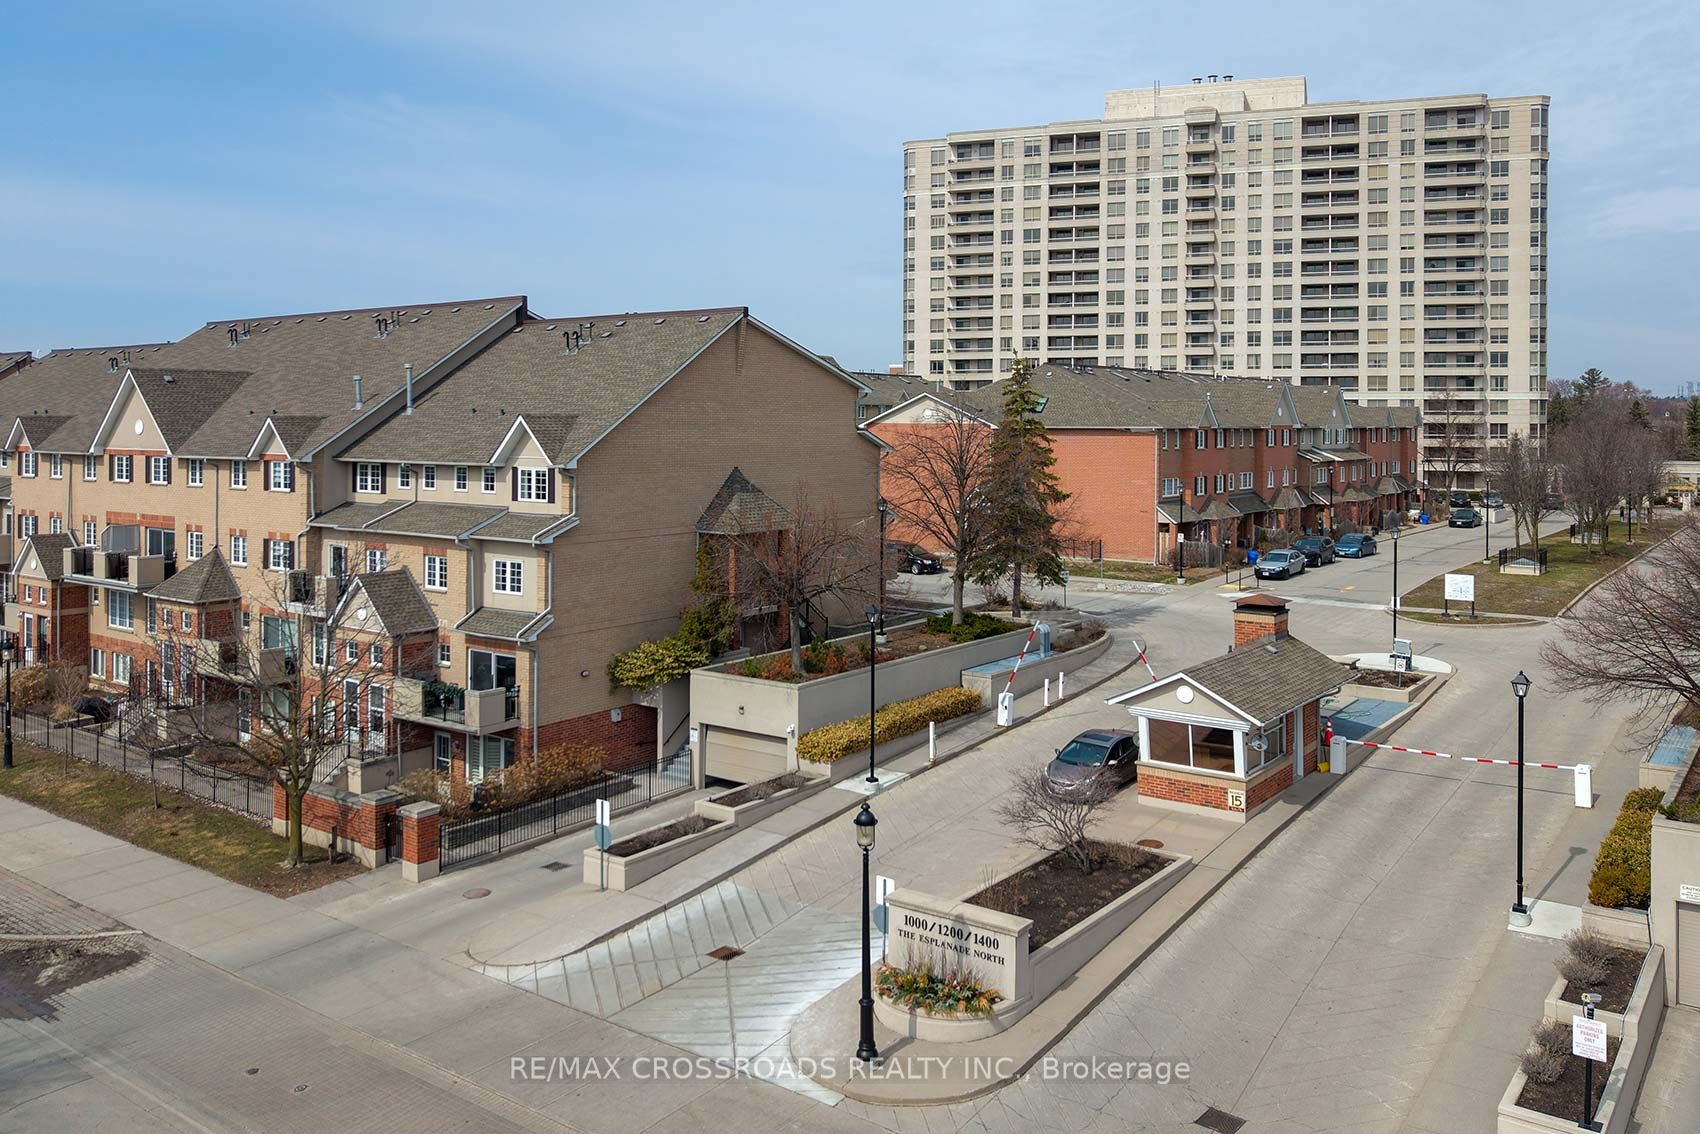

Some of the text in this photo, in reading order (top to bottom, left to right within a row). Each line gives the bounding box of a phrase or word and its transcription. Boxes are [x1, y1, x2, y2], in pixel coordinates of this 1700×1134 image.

[1231, 795, 1243, 807] 15
[904, 914, 1000, 950] 1000/1200/1400
[898, 928, 1005, 966] THE ESPLANADE NORTH
[1580, 1030, 1600, 1039] PARKING
[1584, 1036, 1595, 1044] ONLY
